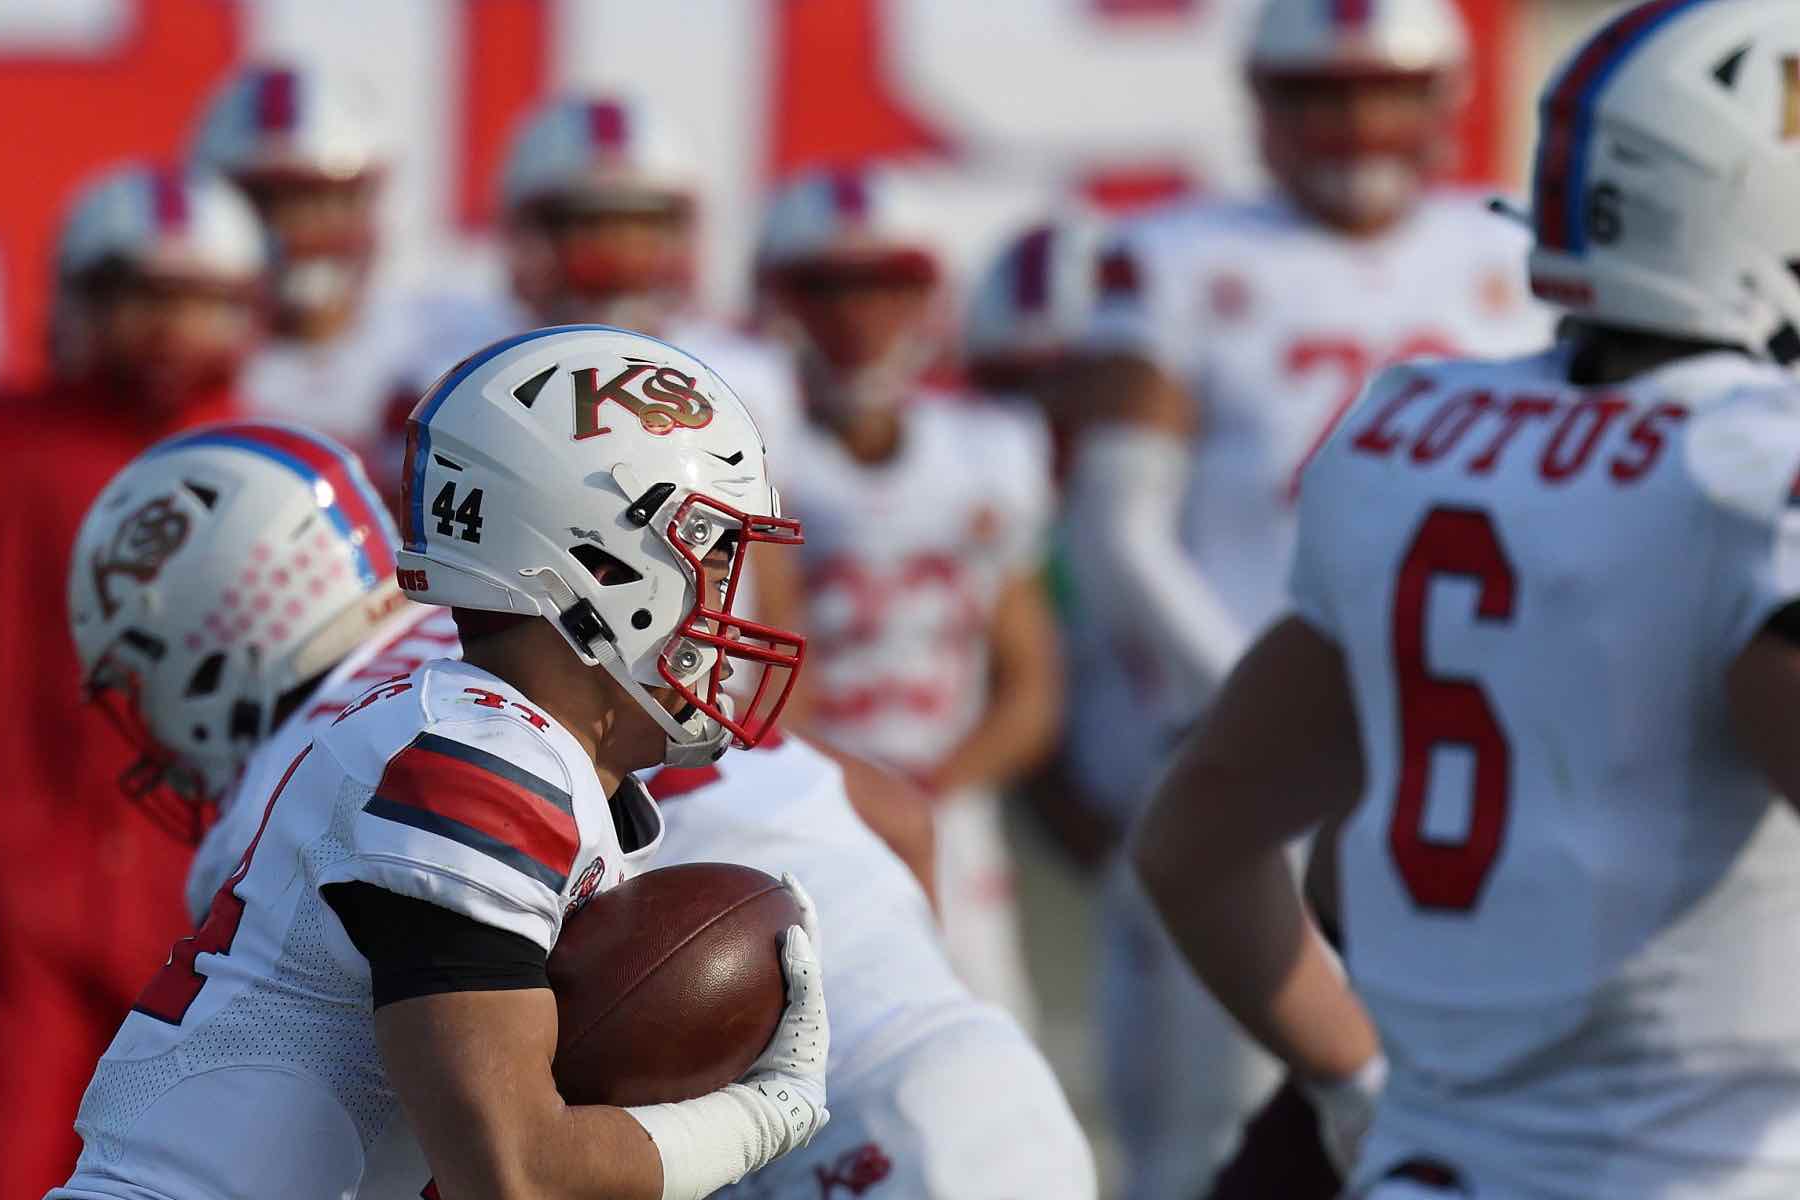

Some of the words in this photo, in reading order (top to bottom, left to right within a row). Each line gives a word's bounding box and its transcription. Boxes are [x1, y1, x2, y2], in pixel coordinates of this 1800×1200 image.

[1351, 377, 1692, 485] LOTUS
[431, 480, 485, 545] 44
[1388, 502, 1522, 920] 6
